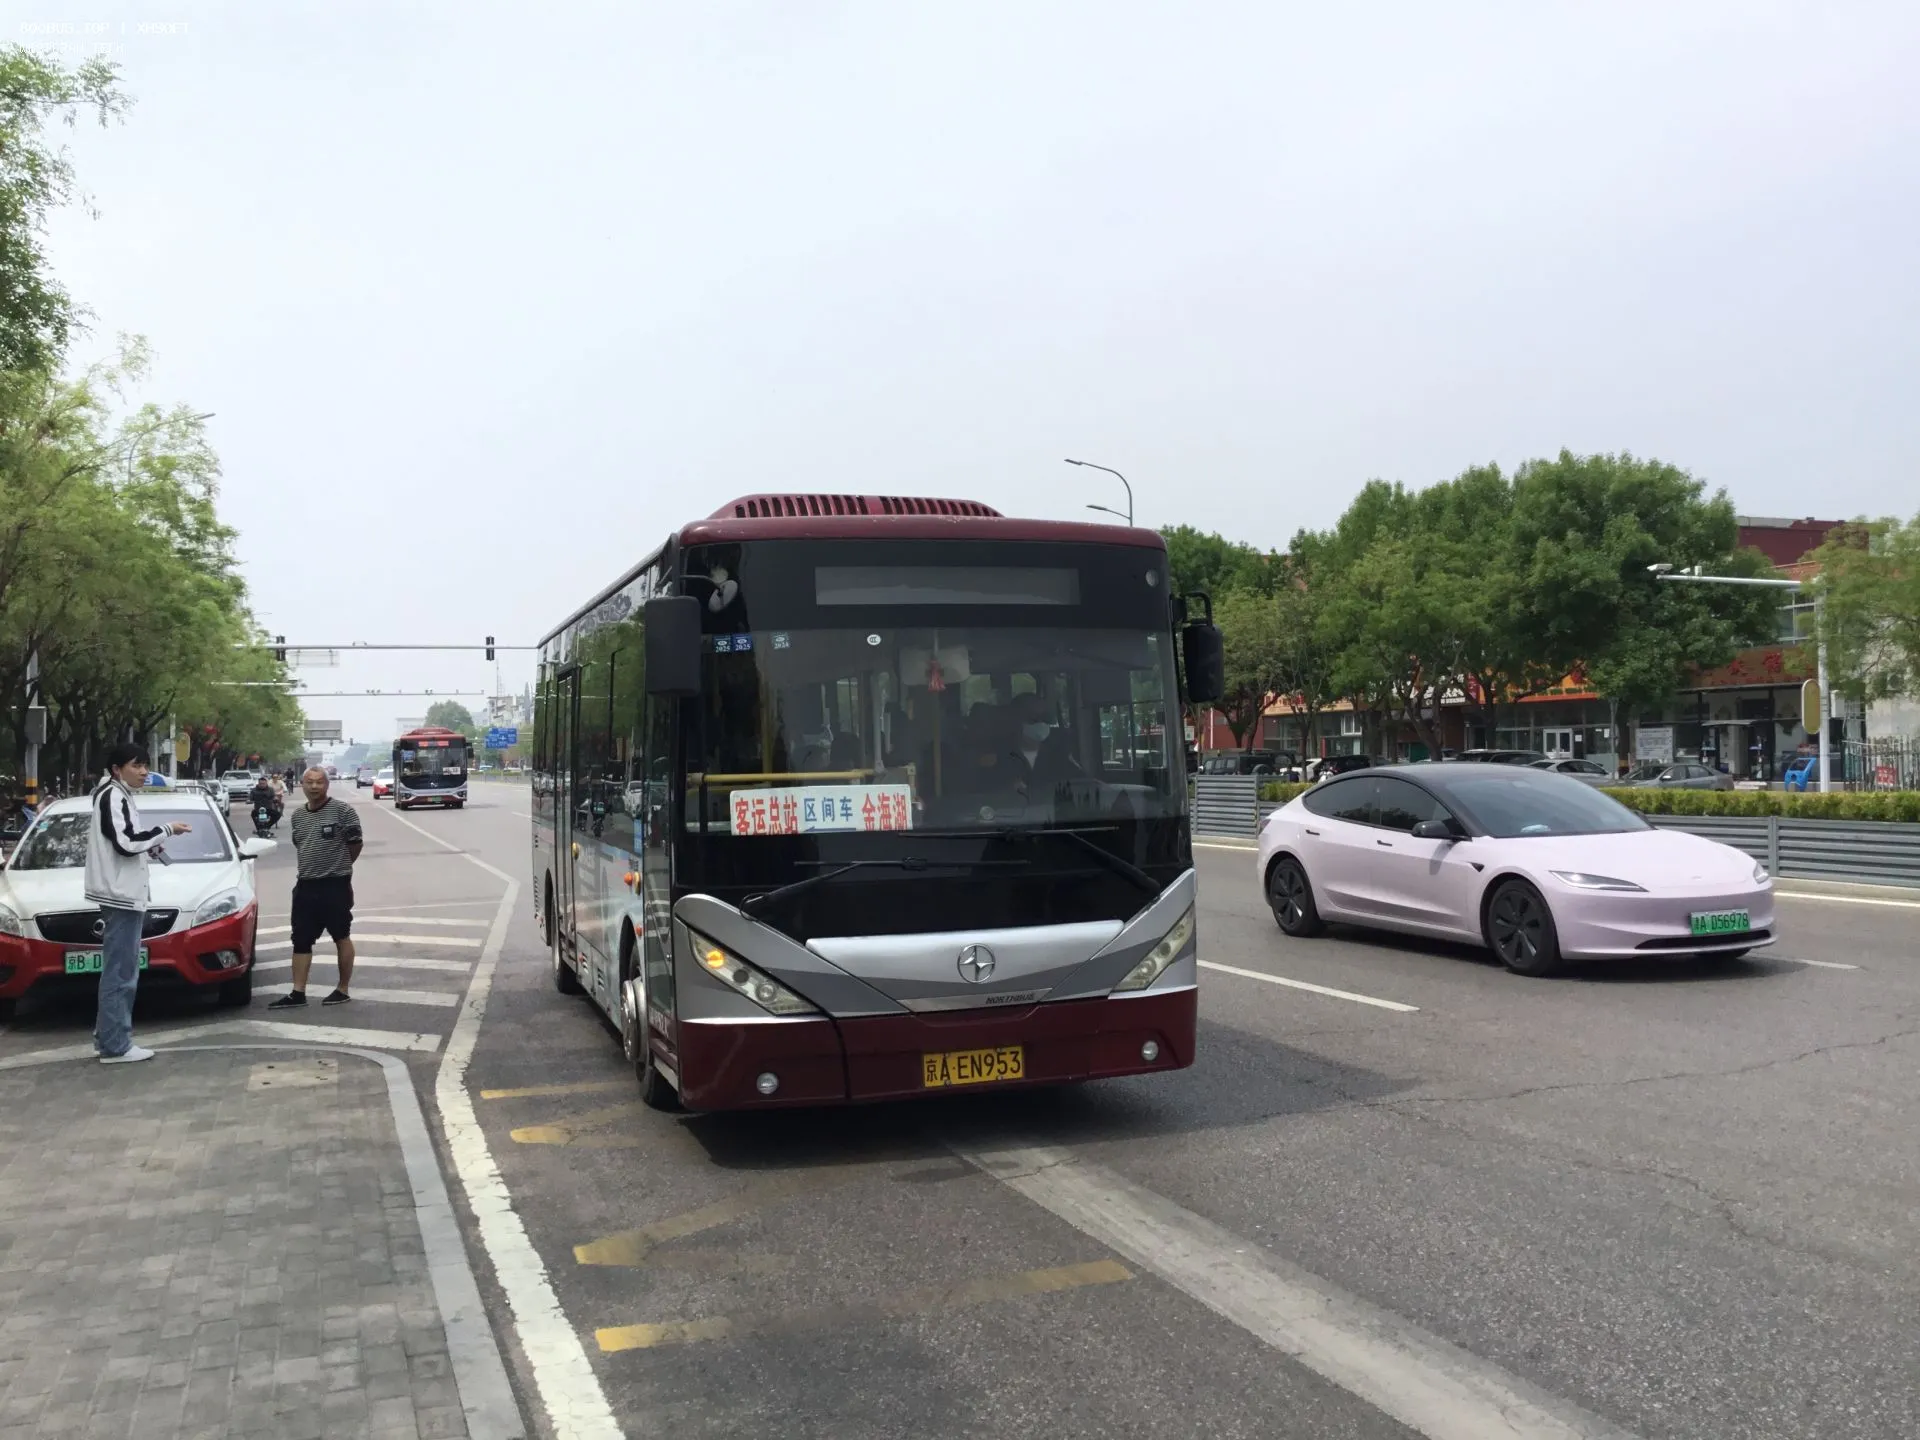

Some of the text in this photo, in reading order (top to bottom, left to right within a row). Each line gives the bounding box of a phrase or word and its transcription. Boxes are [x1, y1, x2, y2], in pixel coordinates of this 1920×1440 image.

[735, 795, 799, 836] 客运总站
[803, 796, 854, 823] 区间车
